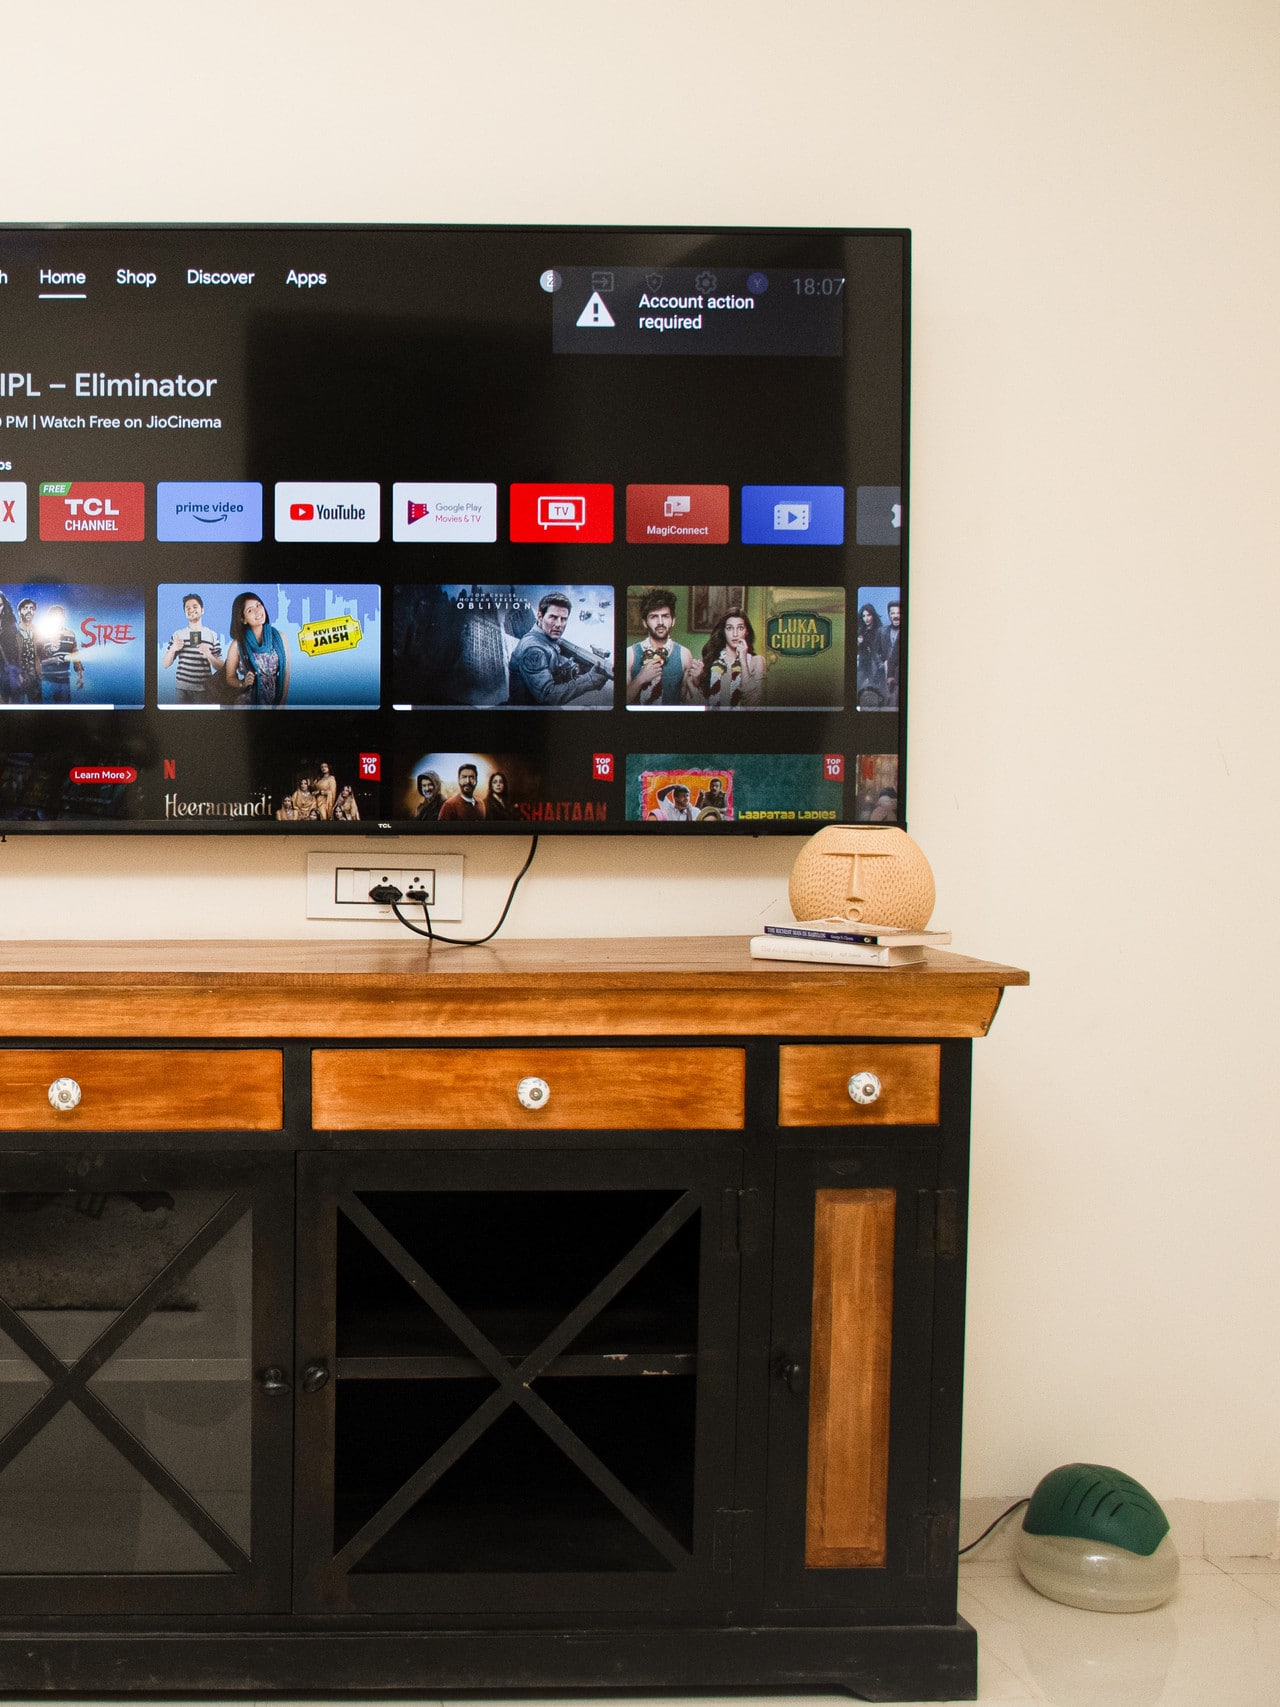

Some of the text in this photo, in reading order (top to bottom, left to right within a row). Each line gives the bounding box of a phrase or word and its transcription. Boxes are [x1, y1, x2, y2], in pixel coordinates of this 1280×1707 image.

[39, 269, 87, 285] Home
[116, 269, 157, 288] Shop
[187, 269, 255, 285] Discover
[285, 269, 328, 288] Apps
[792, 277, 846, 296] 18:07
[638, 293, 755, 310] Account action
[638, 314, 702, 333] required
[0, 372, 41, 397] IPL
[75, 372, 218, 397] Eliminator
[6, 415, 29, 429] PM
[39, 415, 86, 429] Watch
[89, 415, 121, 429] Free
[124, 418, 143, 429] on
[146, 415, 222, 429] JioCinema
[42, 484, 66, 494] FREE
[64, 498, 120, 516] TCL
[175, 501, 244, 515] prime video
[316, 504, 366, 520] YouTube
[435, 502, 483, 514] Google Play
[554, 506, 569, 516] TV
[64, 519, 119, 531] CHANNEL
[435, 515, 463, 523] Movies
[471, 515, 482, 523] TV
[646, 525, 709, 538] MagiConnect
[456, 602, 531, 610] OBLIVION
[312, 624, 348, 637] KEVI RITE
[778, 618, 818, 634] LUKA
[313, 631, 350, 648] JAISH
[771, 634, 825, 649] CHUPPI
[361, 757, 378, 765] TOP
[74, 770, 125, 780] Learn More
[163, 759, 176, 780] N
[362, 764, 377, 774] 10
[596, 764, 610, 775] 10
[826, 765, 841, 775] 10
[164, 792, 273, 821] Heeramandi
[520, 801, 607, 821] SHAITAAN
